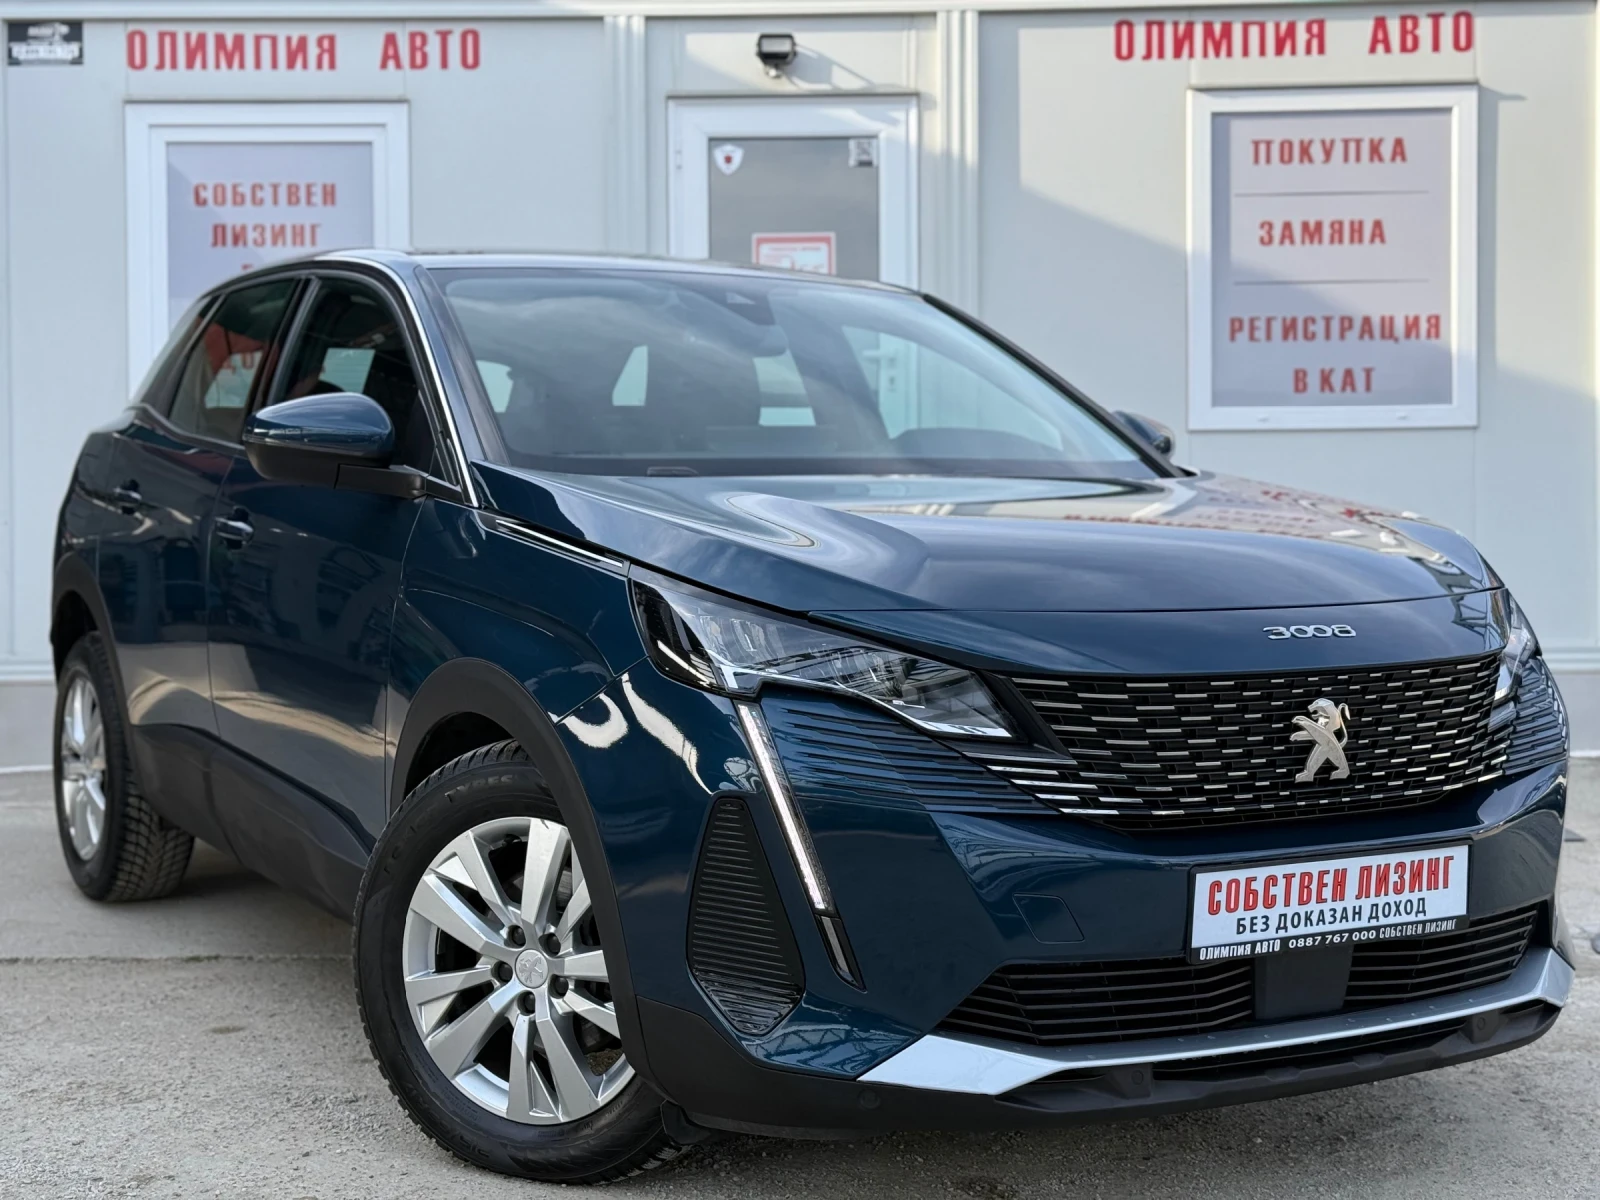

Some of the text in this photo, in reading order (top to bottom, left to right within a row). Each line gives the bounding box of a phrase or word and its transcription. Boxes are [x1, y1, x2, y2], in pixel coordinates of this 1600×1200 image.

[125, 29, 338, 72] ОЛИМПИЯ
[379, 28, 482, 71] АВТО
[1113, 10, 1475, 62] ОЛИМПИЯ АВТО
[1251, 137, 1408, 165] ПОКУПКА
[193, 182, 337, 207] СОБСТВЕН
[211, 223, 322, 248] ЛИЗИНГ
[1258, 219, 1387, 247] ЗАМЯНА
[1228, 314, 1442, 344] РЕГИСТРАЦИЯ
[1292, 367, 1376, 395] В КАТ
[1262, 624, 1357, 640] 3008
[1207, 855, 1455, 916] СОБСТВЕН ЛИЗИНГ
[1235, 897, 1428, 935] БЕЗ ДОКАЗАН ДОХОД
[1199, 918, 1457, 961] ОЛИМПИЯ АВТО 0887 767 000 СОБСТВЕН ЛИЗИНГ
